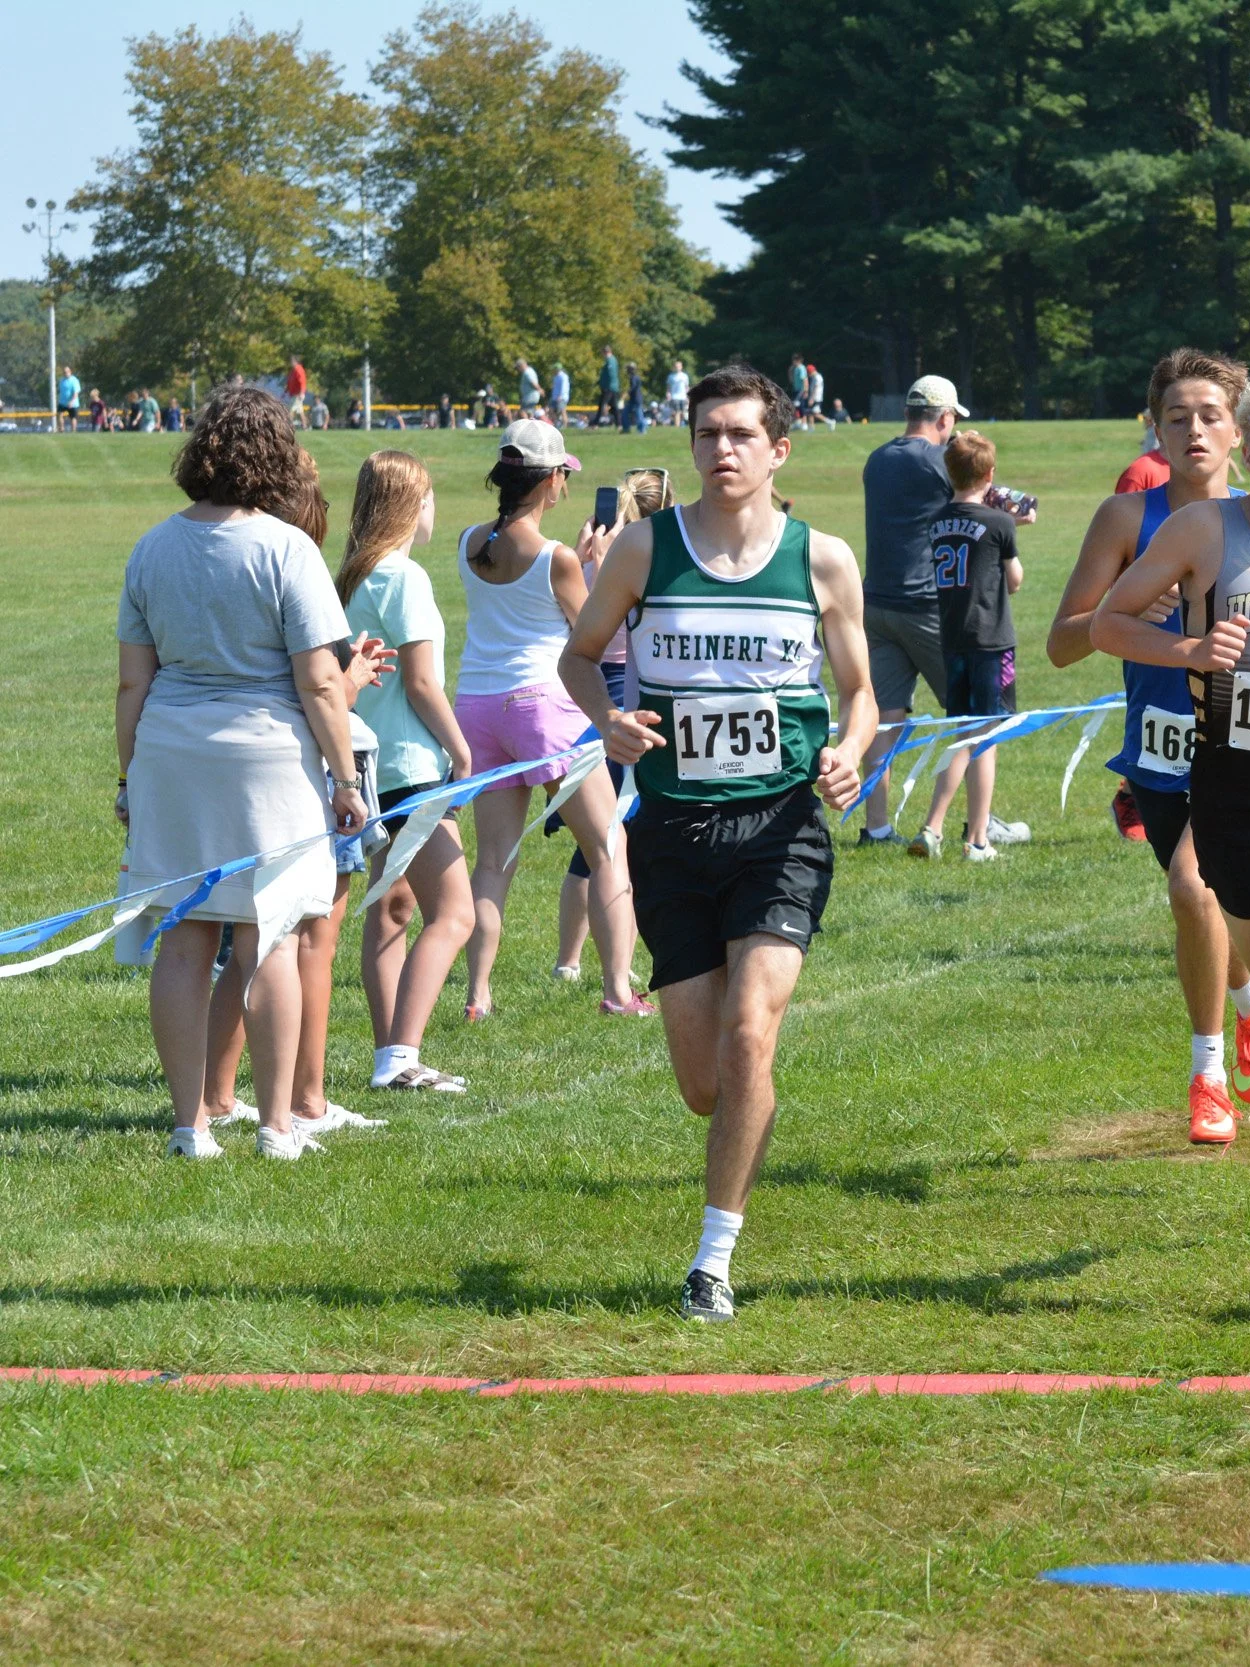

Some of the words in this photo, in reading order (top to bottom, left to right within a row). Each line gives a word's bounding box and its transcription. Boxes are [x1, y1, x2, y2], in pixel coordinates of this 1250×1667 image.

[934, 543, 969, 588] 21
[652, 633, 767, 662] STEINERT
[679, 709, 776, 759] 1753
[1145, 719, 1197, 763] 168
